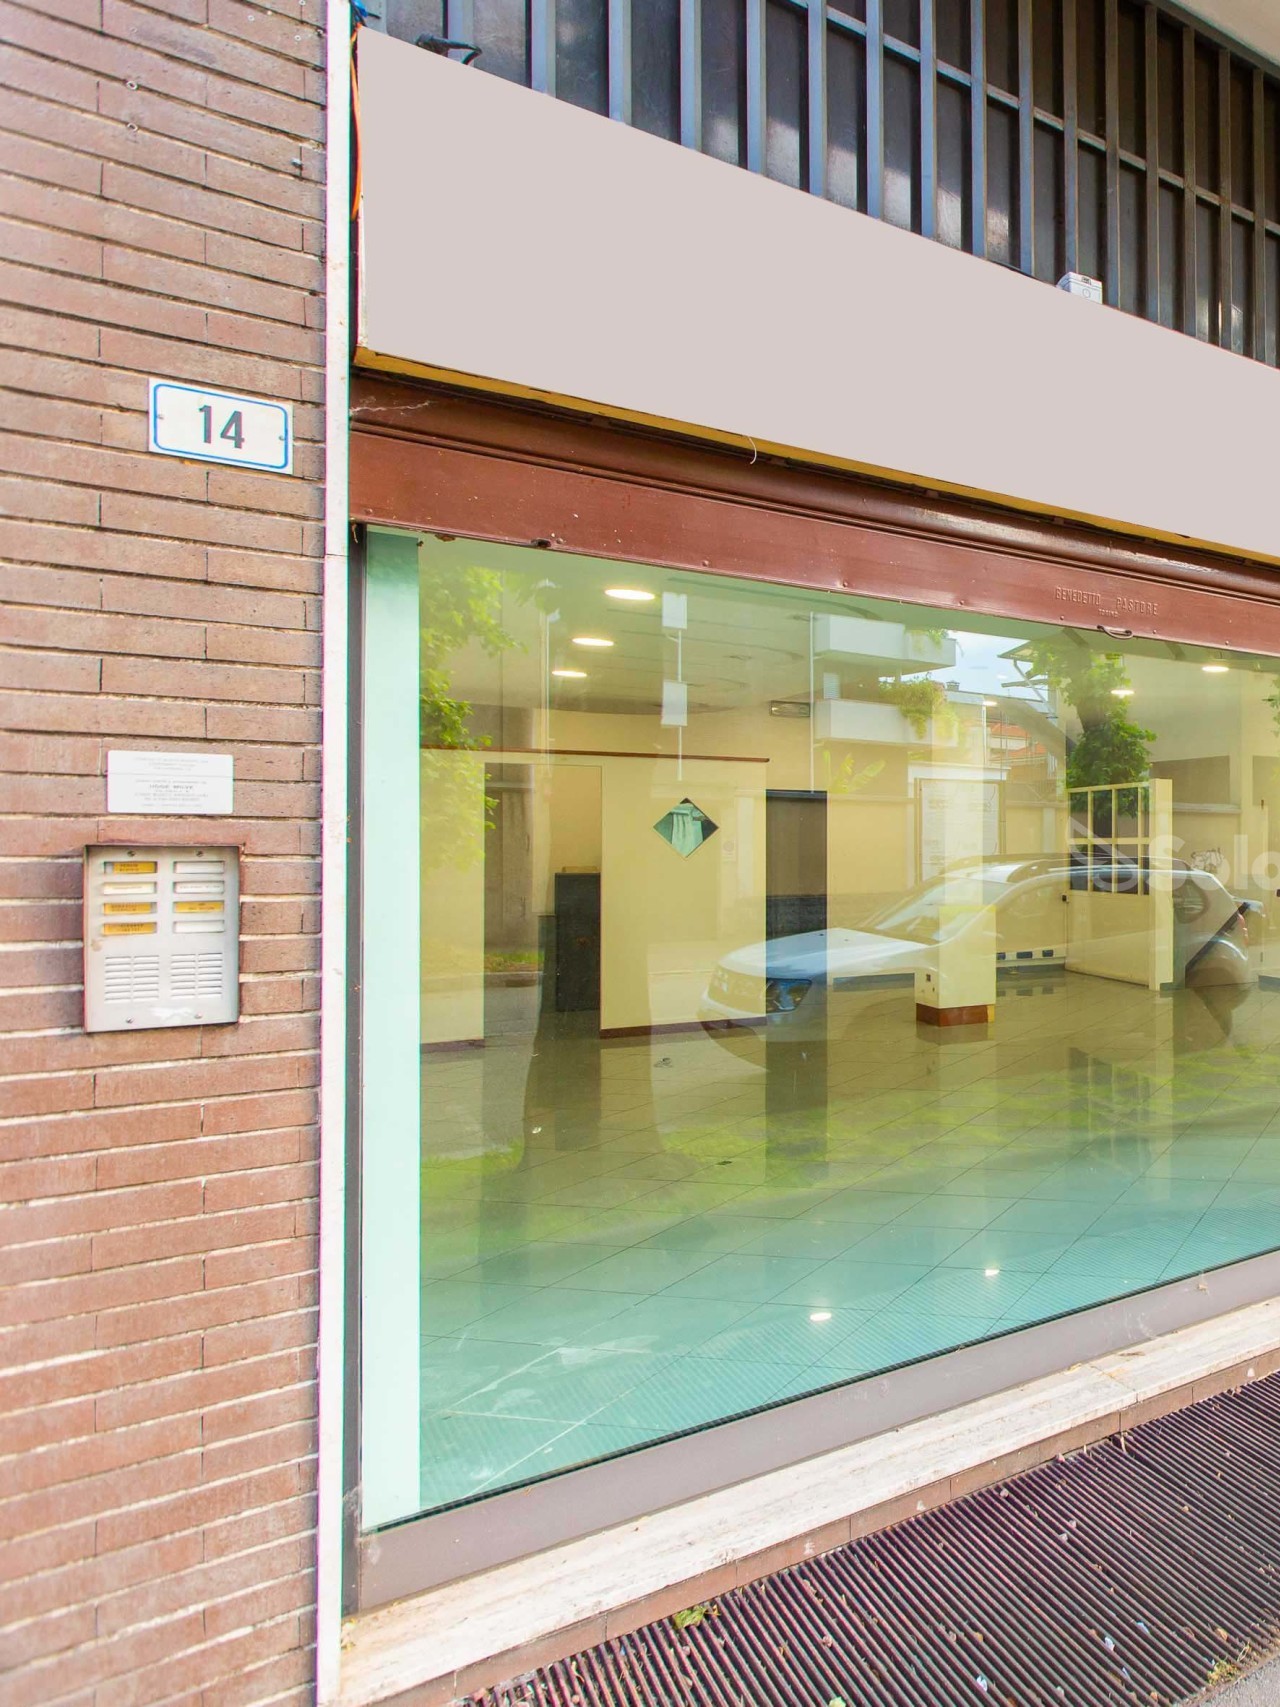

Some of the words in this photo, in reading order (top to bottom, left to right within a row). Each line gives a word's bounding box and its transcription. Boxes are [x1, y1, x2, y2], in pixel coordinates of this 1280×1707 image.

[197, 405, 246, 450] 14
[1055, 587, 1101, 605] BENEDETTO
[1116, 597, 1159, 616] PASTORE
